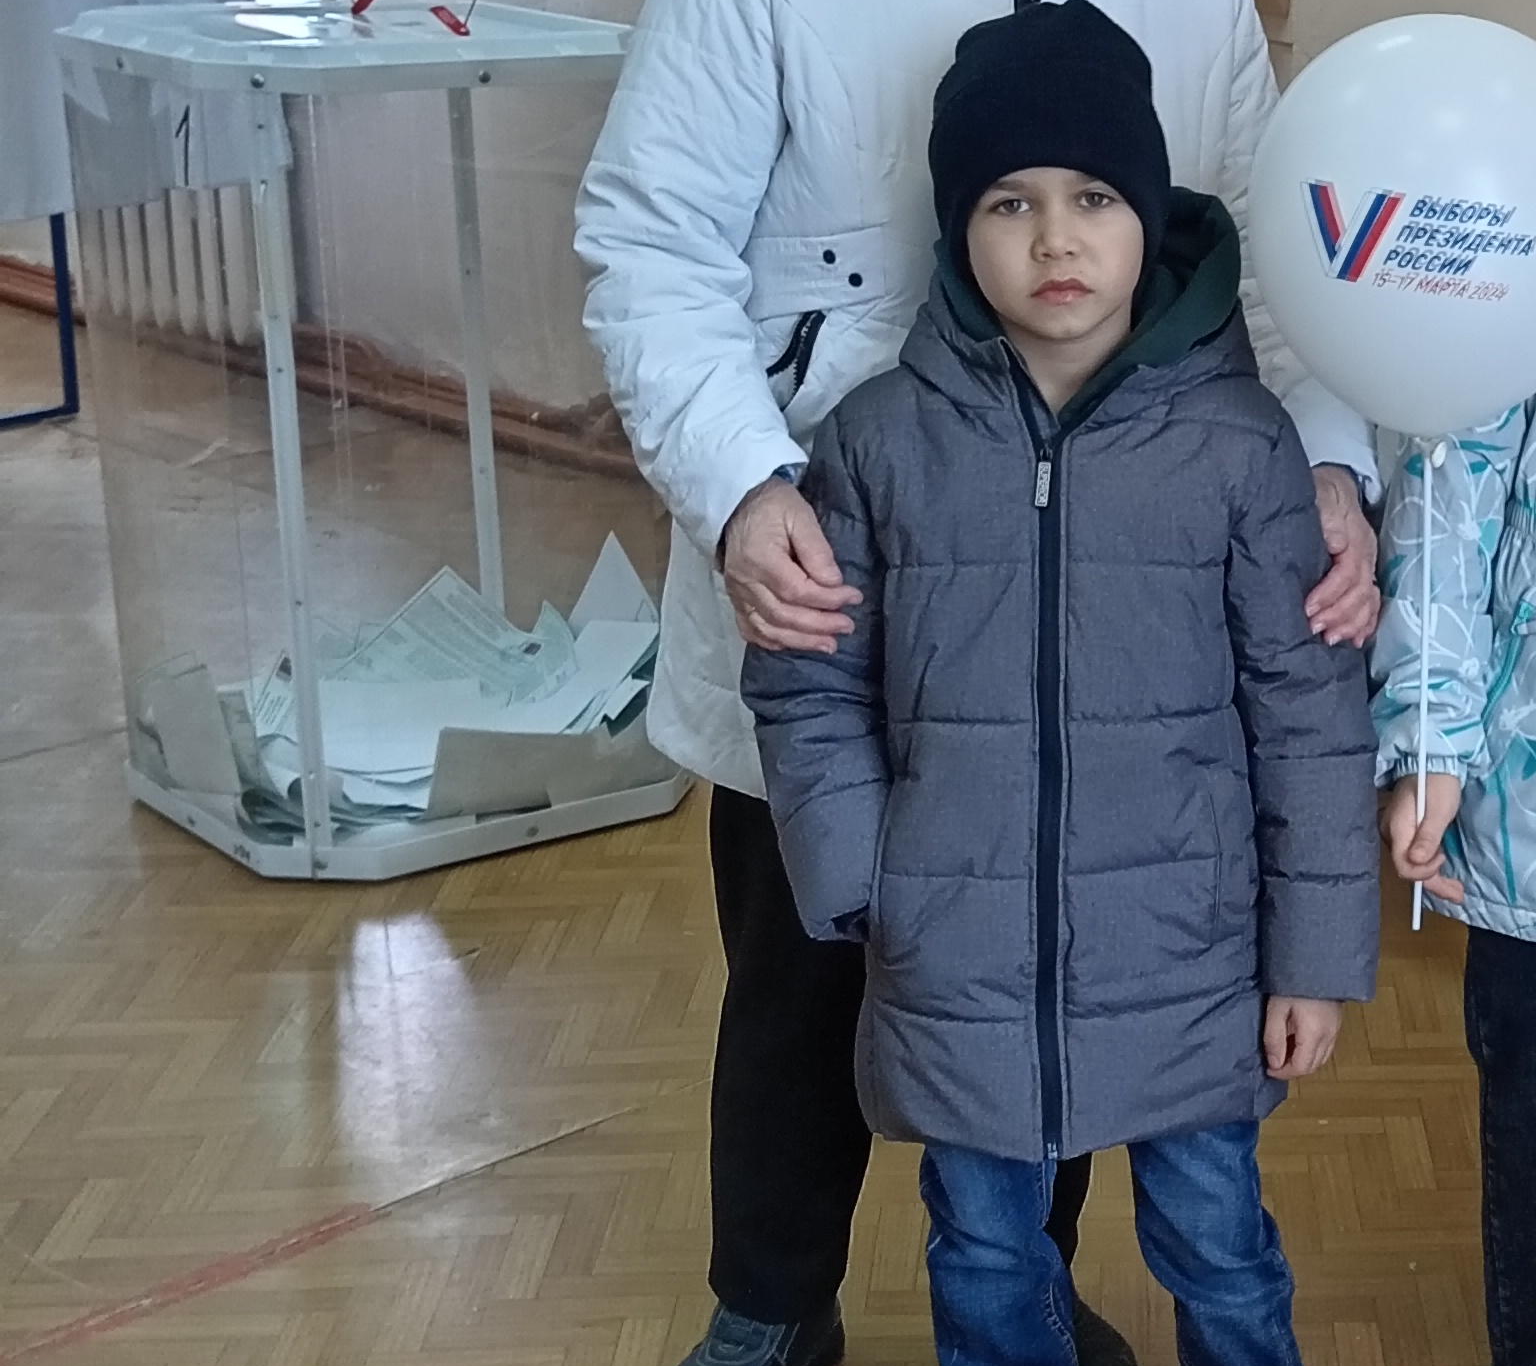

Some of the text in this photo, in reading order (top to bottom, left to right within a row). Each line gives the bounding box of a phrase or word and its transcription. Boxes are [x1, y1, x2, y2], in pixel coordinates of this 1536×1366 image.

[174, 104, 191, 187] 1
[1409, 195, 1517, 227] ВЫБОРЫ
[1383, 245, 1478, 276] РОССИИ
[1416, 275, 1472, 298] МАРТА
[1468, 282, 1510, 302] 2024
